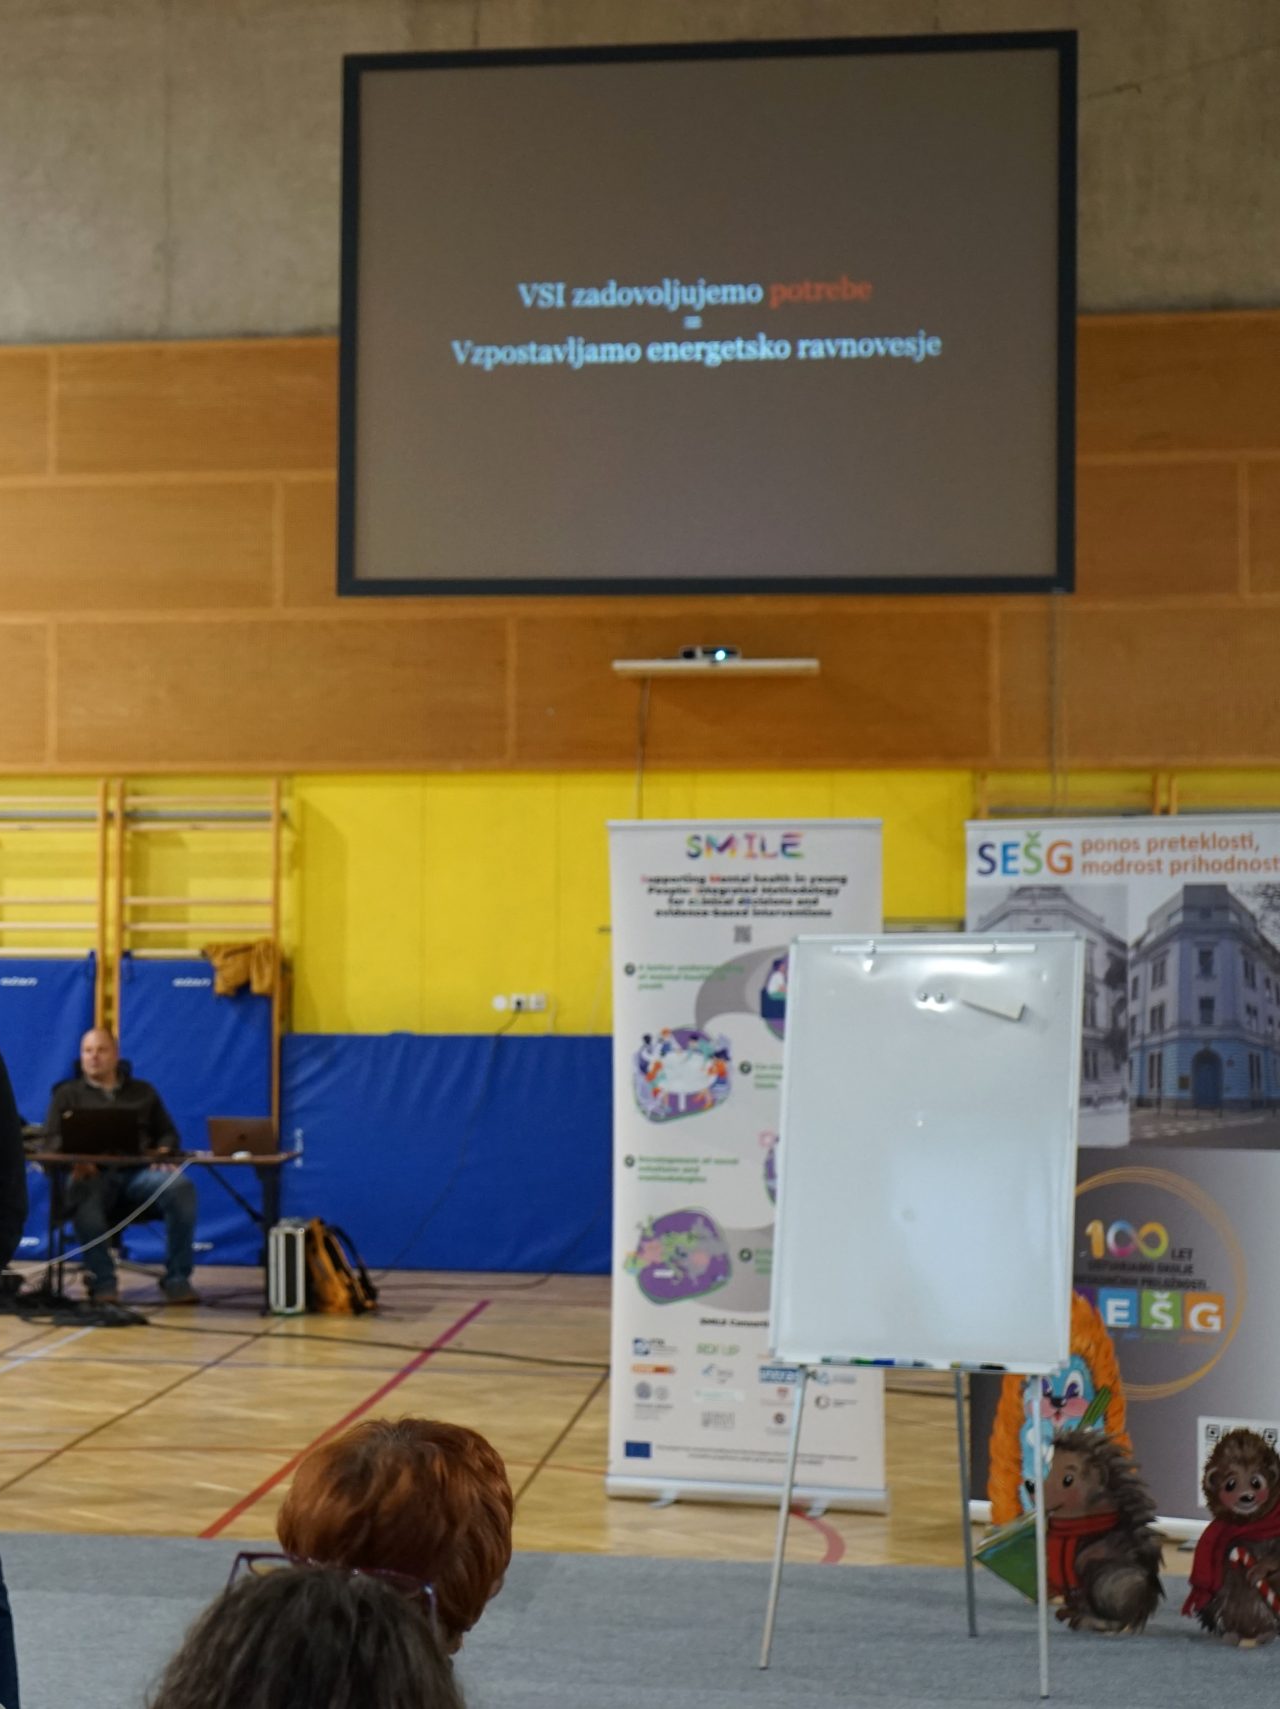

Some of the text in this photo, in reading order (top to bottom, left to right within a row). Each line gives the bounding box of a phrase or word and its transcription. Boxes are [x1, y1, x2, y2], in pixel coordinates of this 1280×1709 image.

[518, 275, 872, 312] VSI zadovoljujemo potrebe
[451, 330, 942, 370] Vzpostavljamo energetsko ravnovesje
[686, 832, 805, 859] SMILE
[977, 830, 1259, 876] SEŠG ponos preteklosti,
[1081, 854, 1280, 877] modrost prihodnost
[1085, 1219, 1169, 1260] 100
[1106, 1291, 1221, 1333] EŠG
